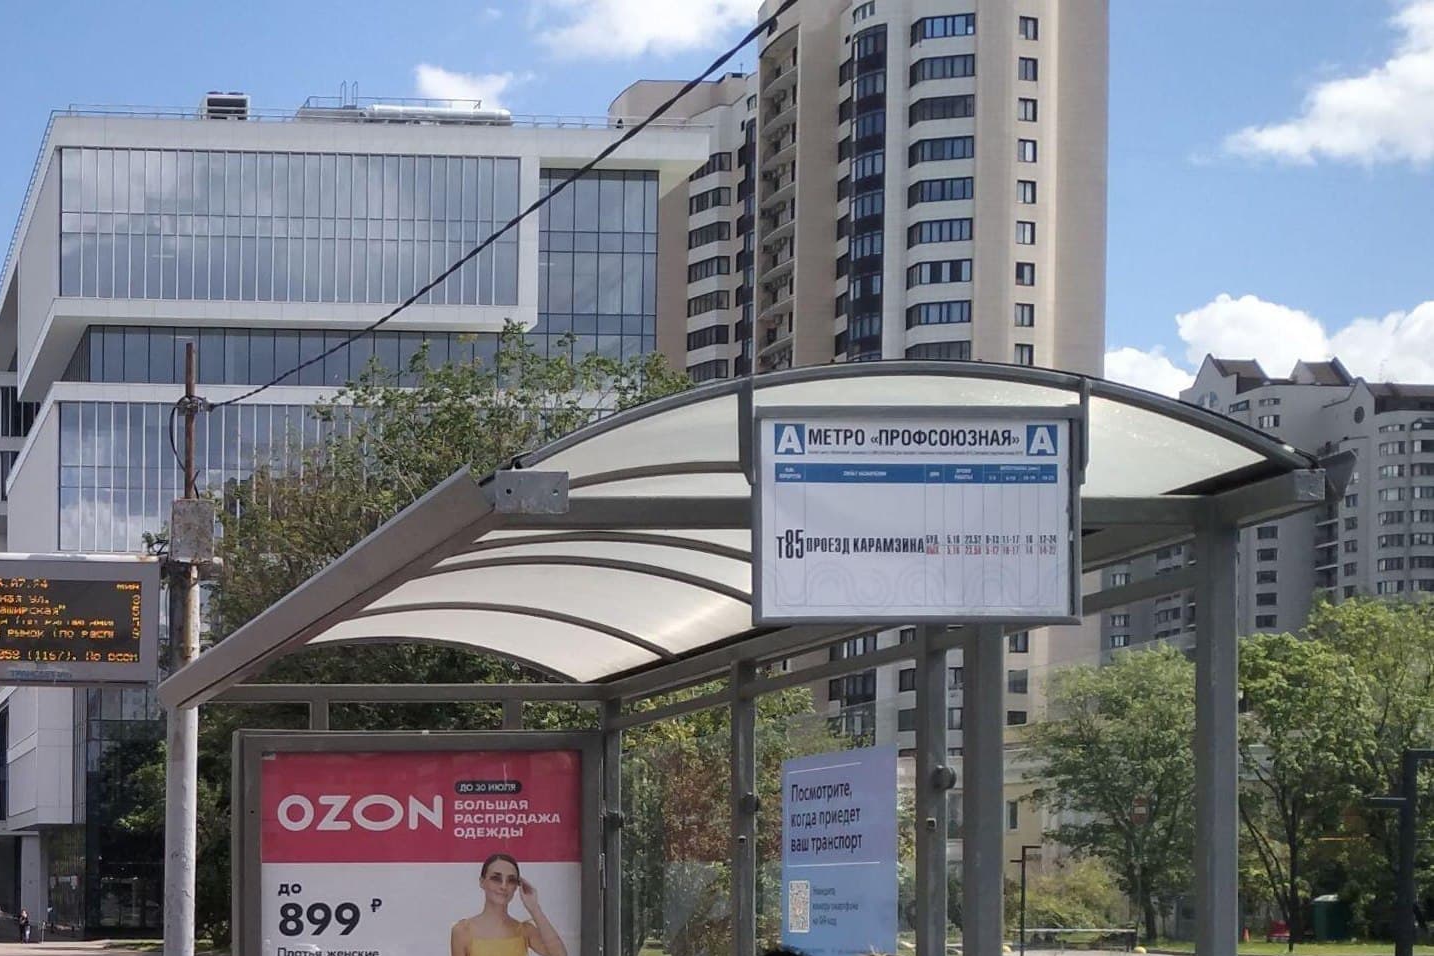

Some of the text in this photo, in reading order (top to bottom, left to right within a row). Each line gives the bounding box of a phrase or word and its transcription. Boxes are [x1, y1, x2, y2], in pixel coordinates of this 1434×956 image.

[808, 428, 865, 446] МЕТРО
[870, 429, 1020, 446] «ПРОФСОЮЗНАЯ»
[806, 538, 850, 554] ПРОЕЗД
[853, 538, 924, 552] КАРАМЗИНА
[792, 781, 852, 802] Посмотрите,
[277, 795, 443, 831] OZON
[454, 800, 528, 810] БОЛЬШАЯ
[454, 814, 560, 824] РАСПРОДАЖА
[791, 807, 860, 830] когда приедет
[454, 828, 524, 838] ОДЕЖДЫ
[791, 834, 862, 854] ваш транспорт
[278, 884, 302, 896] до
[278, 902, 360, 936] 899
